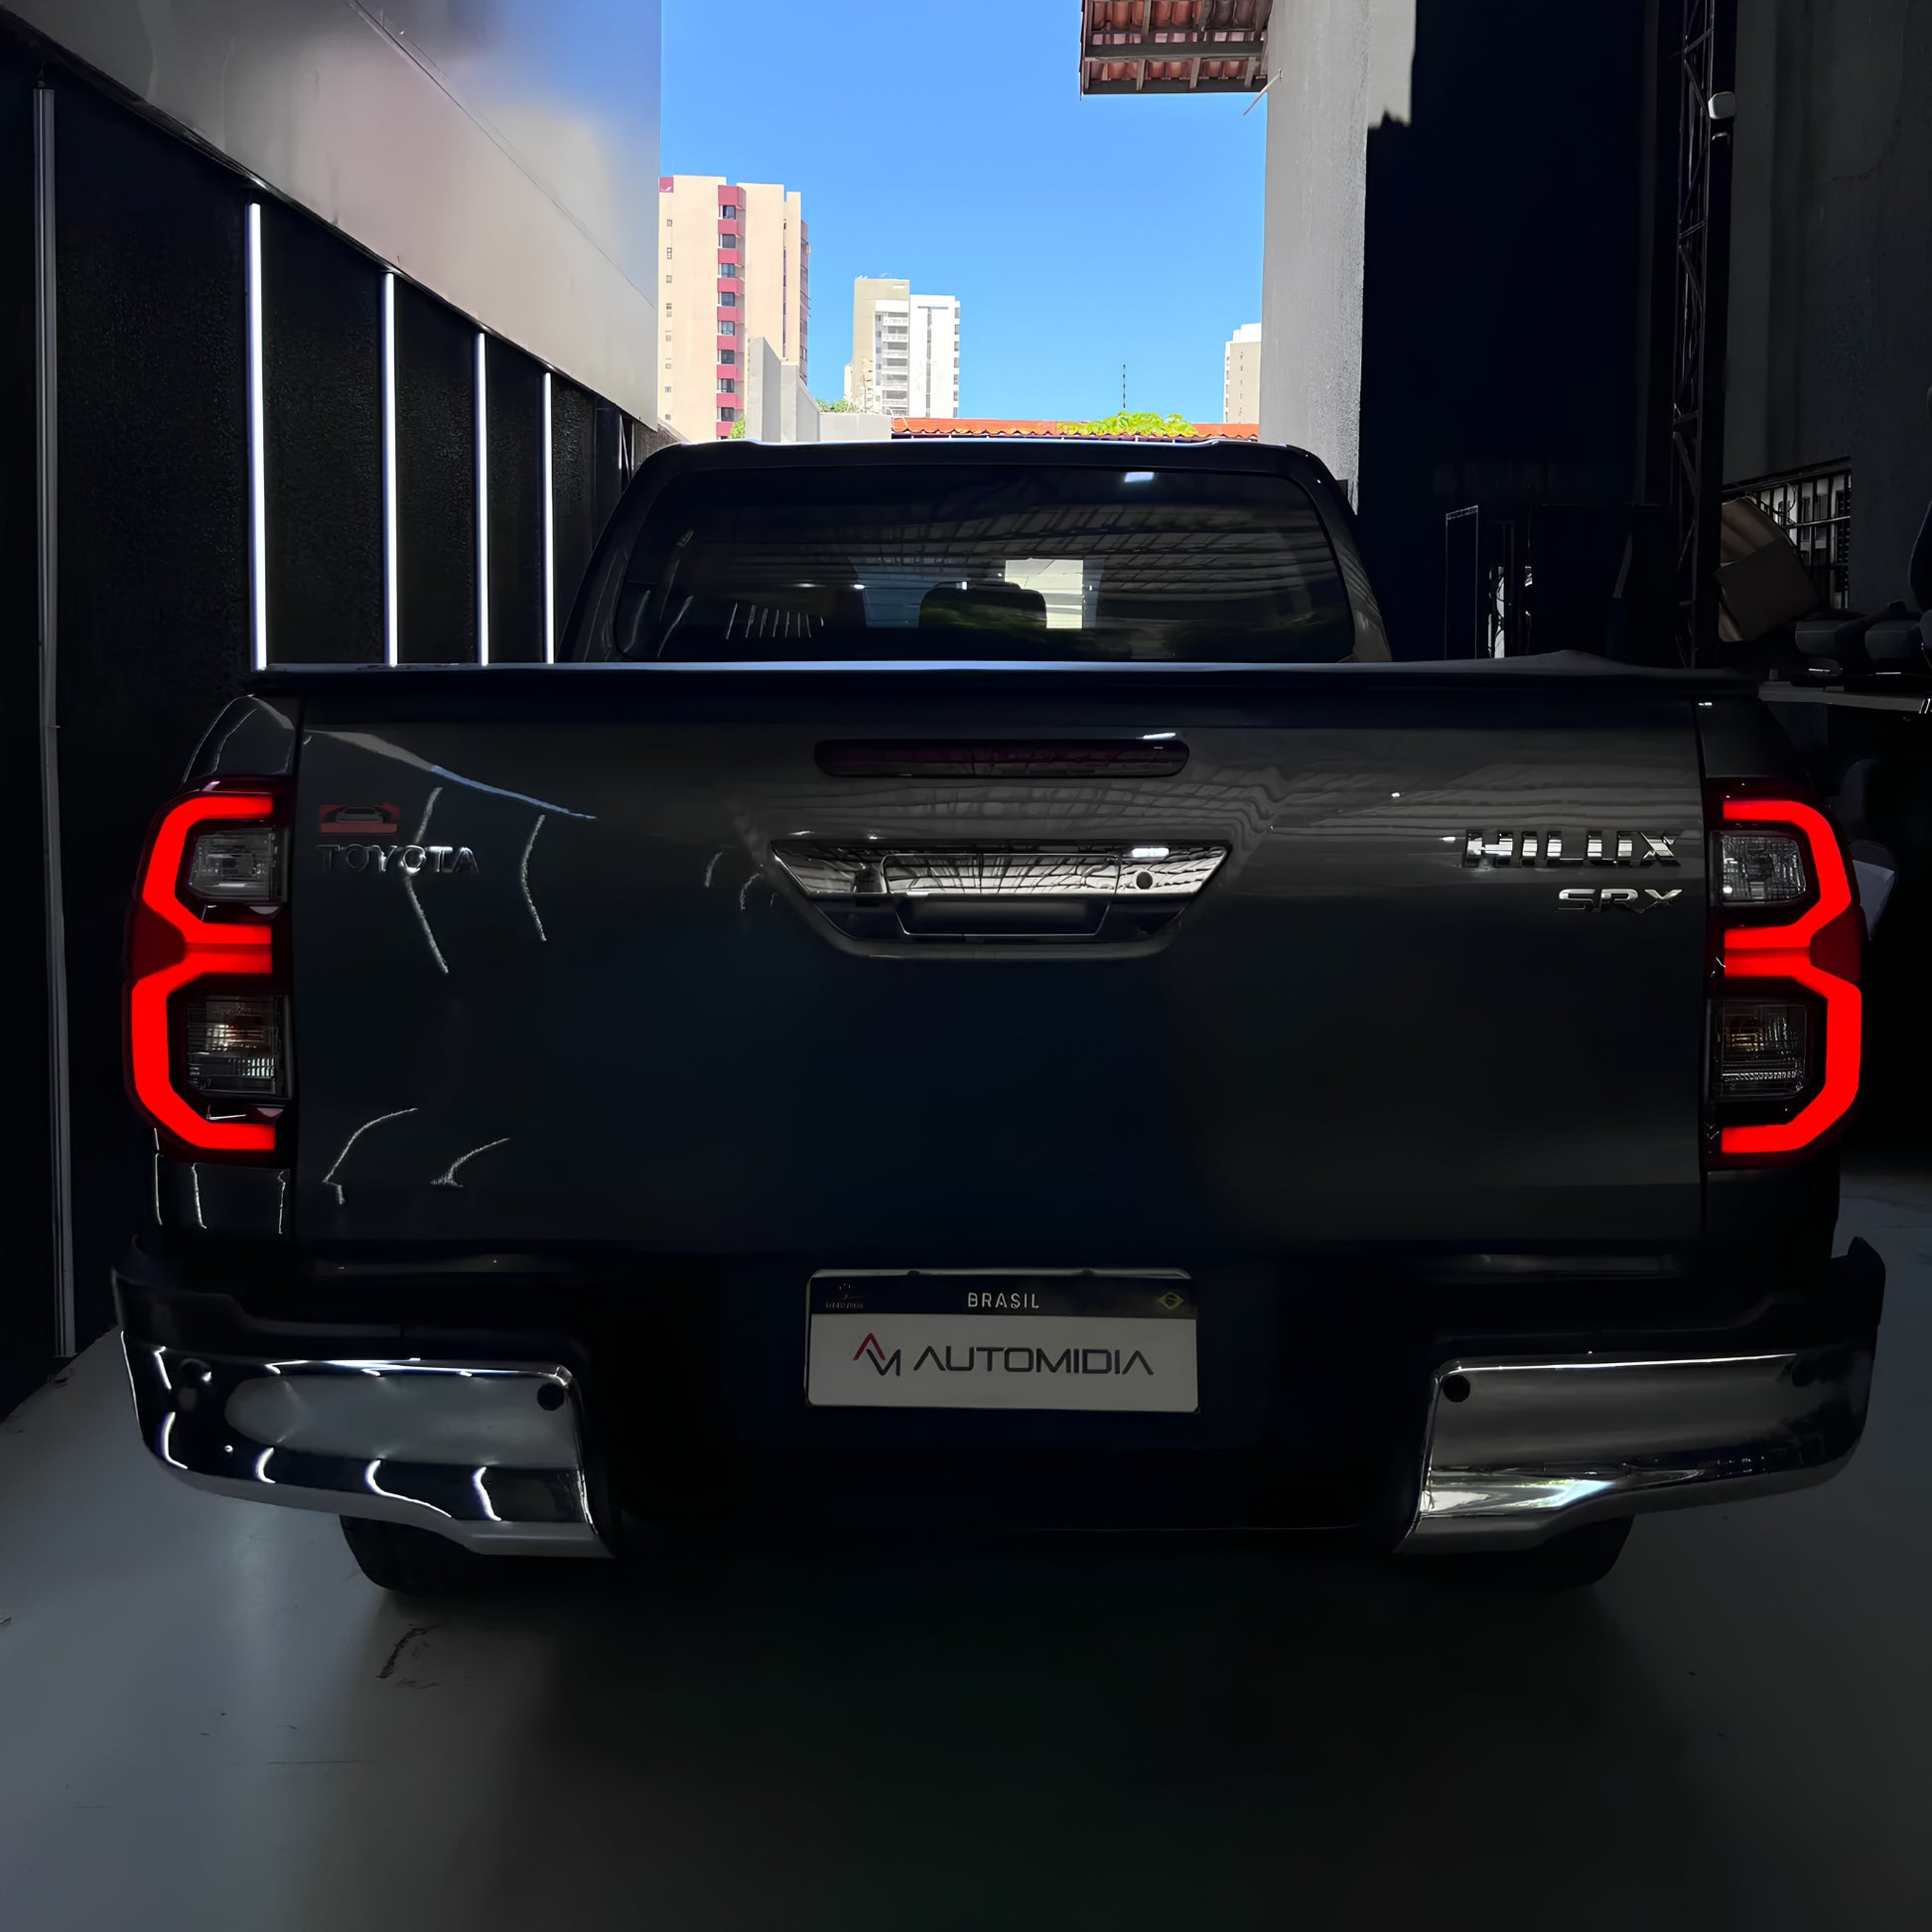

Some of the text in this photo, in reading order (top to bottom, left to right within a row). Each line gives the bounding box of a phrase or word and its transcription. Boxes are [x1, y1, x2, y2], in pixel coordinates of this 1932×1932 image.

[316, 844, 479, 874] TOYOTA
[1462, 831, 1681, 868] HILUX
[1557, 889, 1683, 913] SRX
[967, 1292, 1039, 1310] BRASIL
[912, 1345, 1154, 1376] AUTOMIDIA
